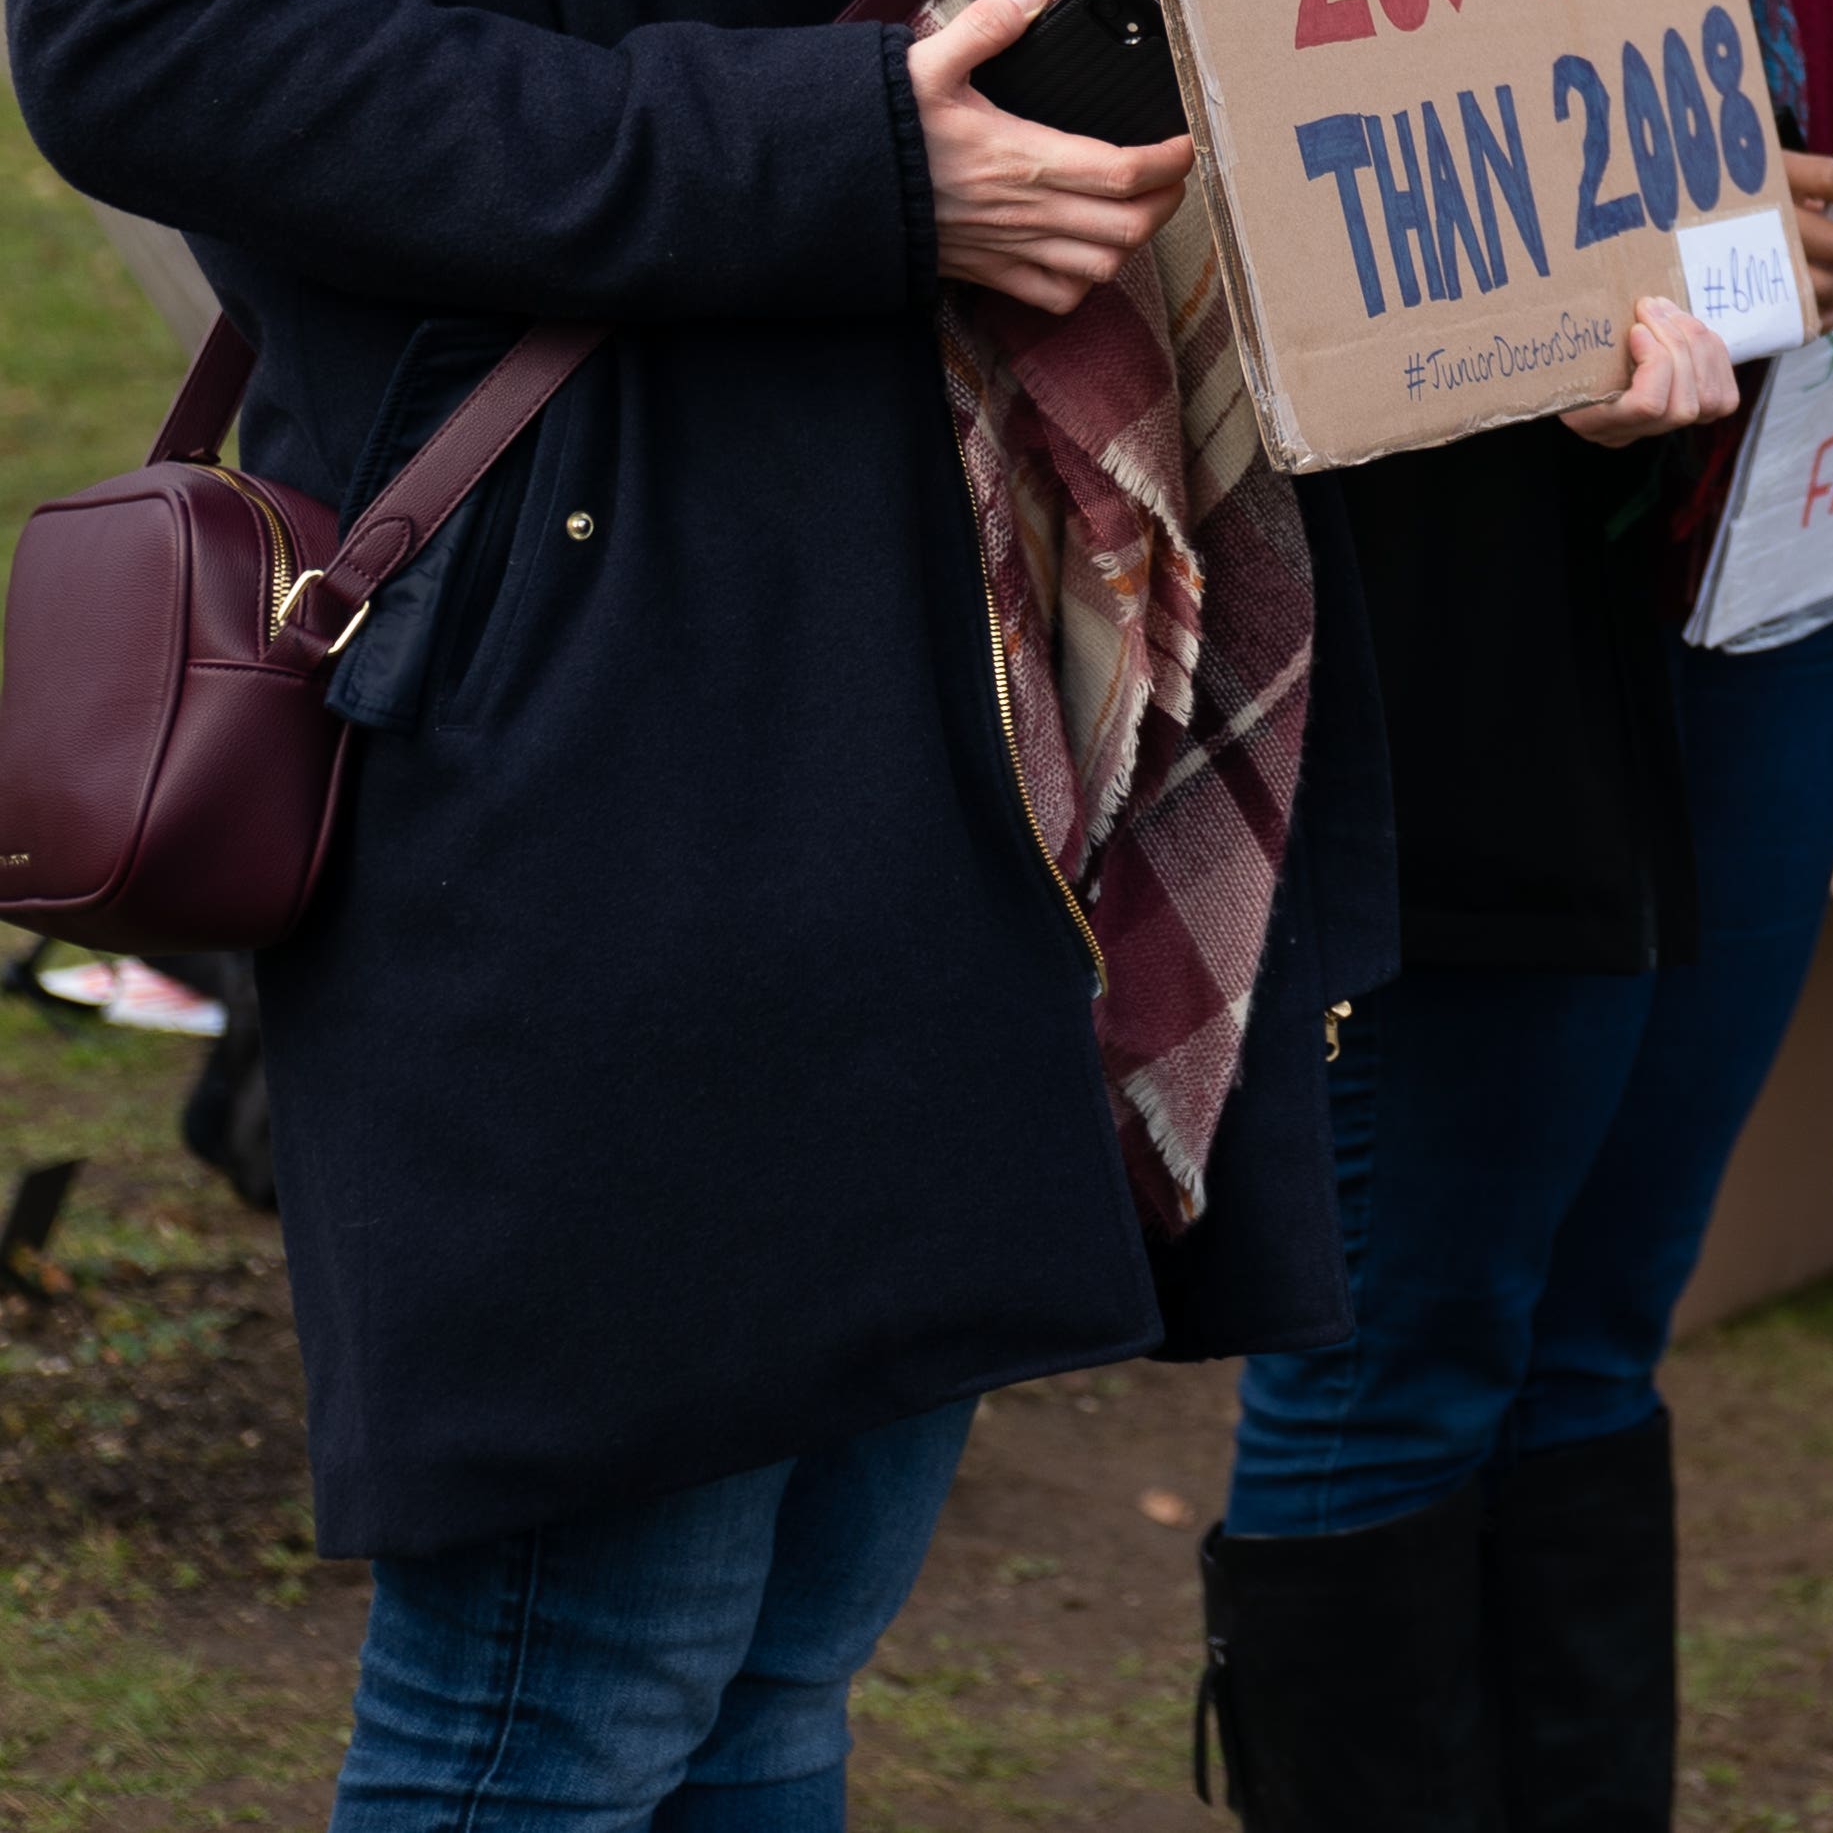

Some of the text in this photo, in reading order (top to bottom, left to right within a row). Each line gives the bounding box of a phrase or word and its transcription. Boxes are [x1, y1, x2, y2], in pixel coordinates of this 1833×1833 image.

[1296, 5, 1768, 319] THAN 2008
[1703, 246, 1790, 319] #BMA
[1404, 311, 1616, 402] #JuniorDoctorsStrike
